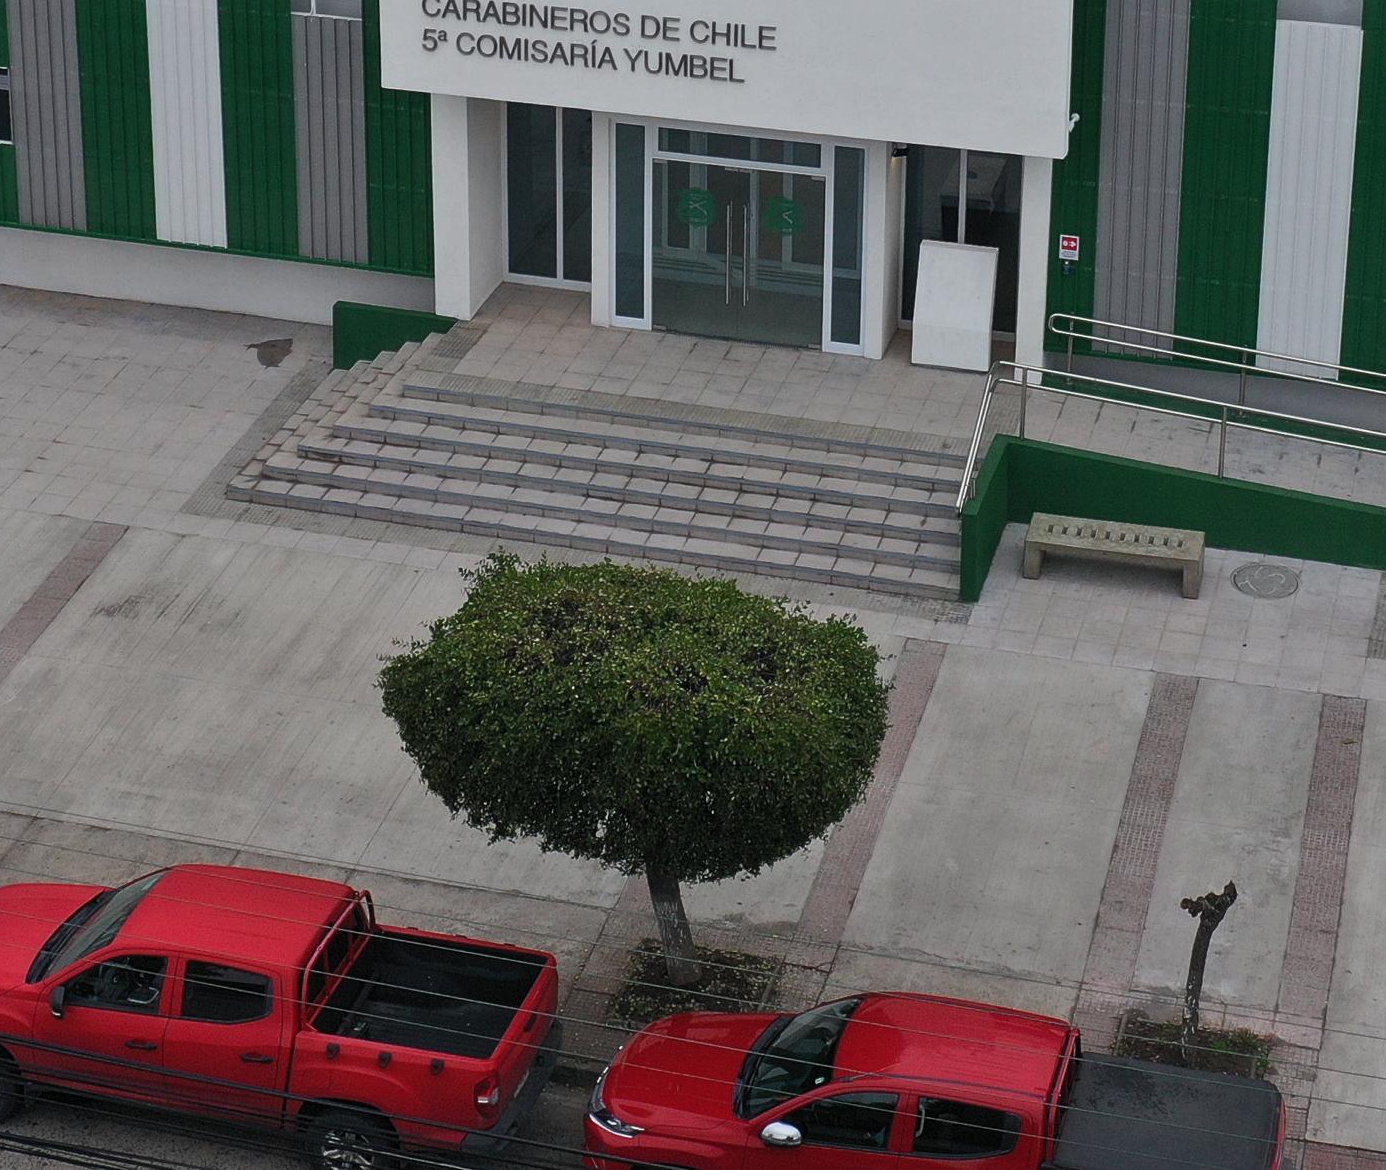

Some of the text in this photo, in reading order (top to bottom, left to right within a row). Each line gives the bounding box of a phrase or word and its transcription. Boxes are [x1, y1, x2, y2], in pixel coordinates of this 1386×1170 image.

[640, 14, 681, 42] DE
[689, 20, 777, 51] CHILE
[456, 32, 618, 71] COMISARÍA
[623, 47, 745, 83] YUMBEL
